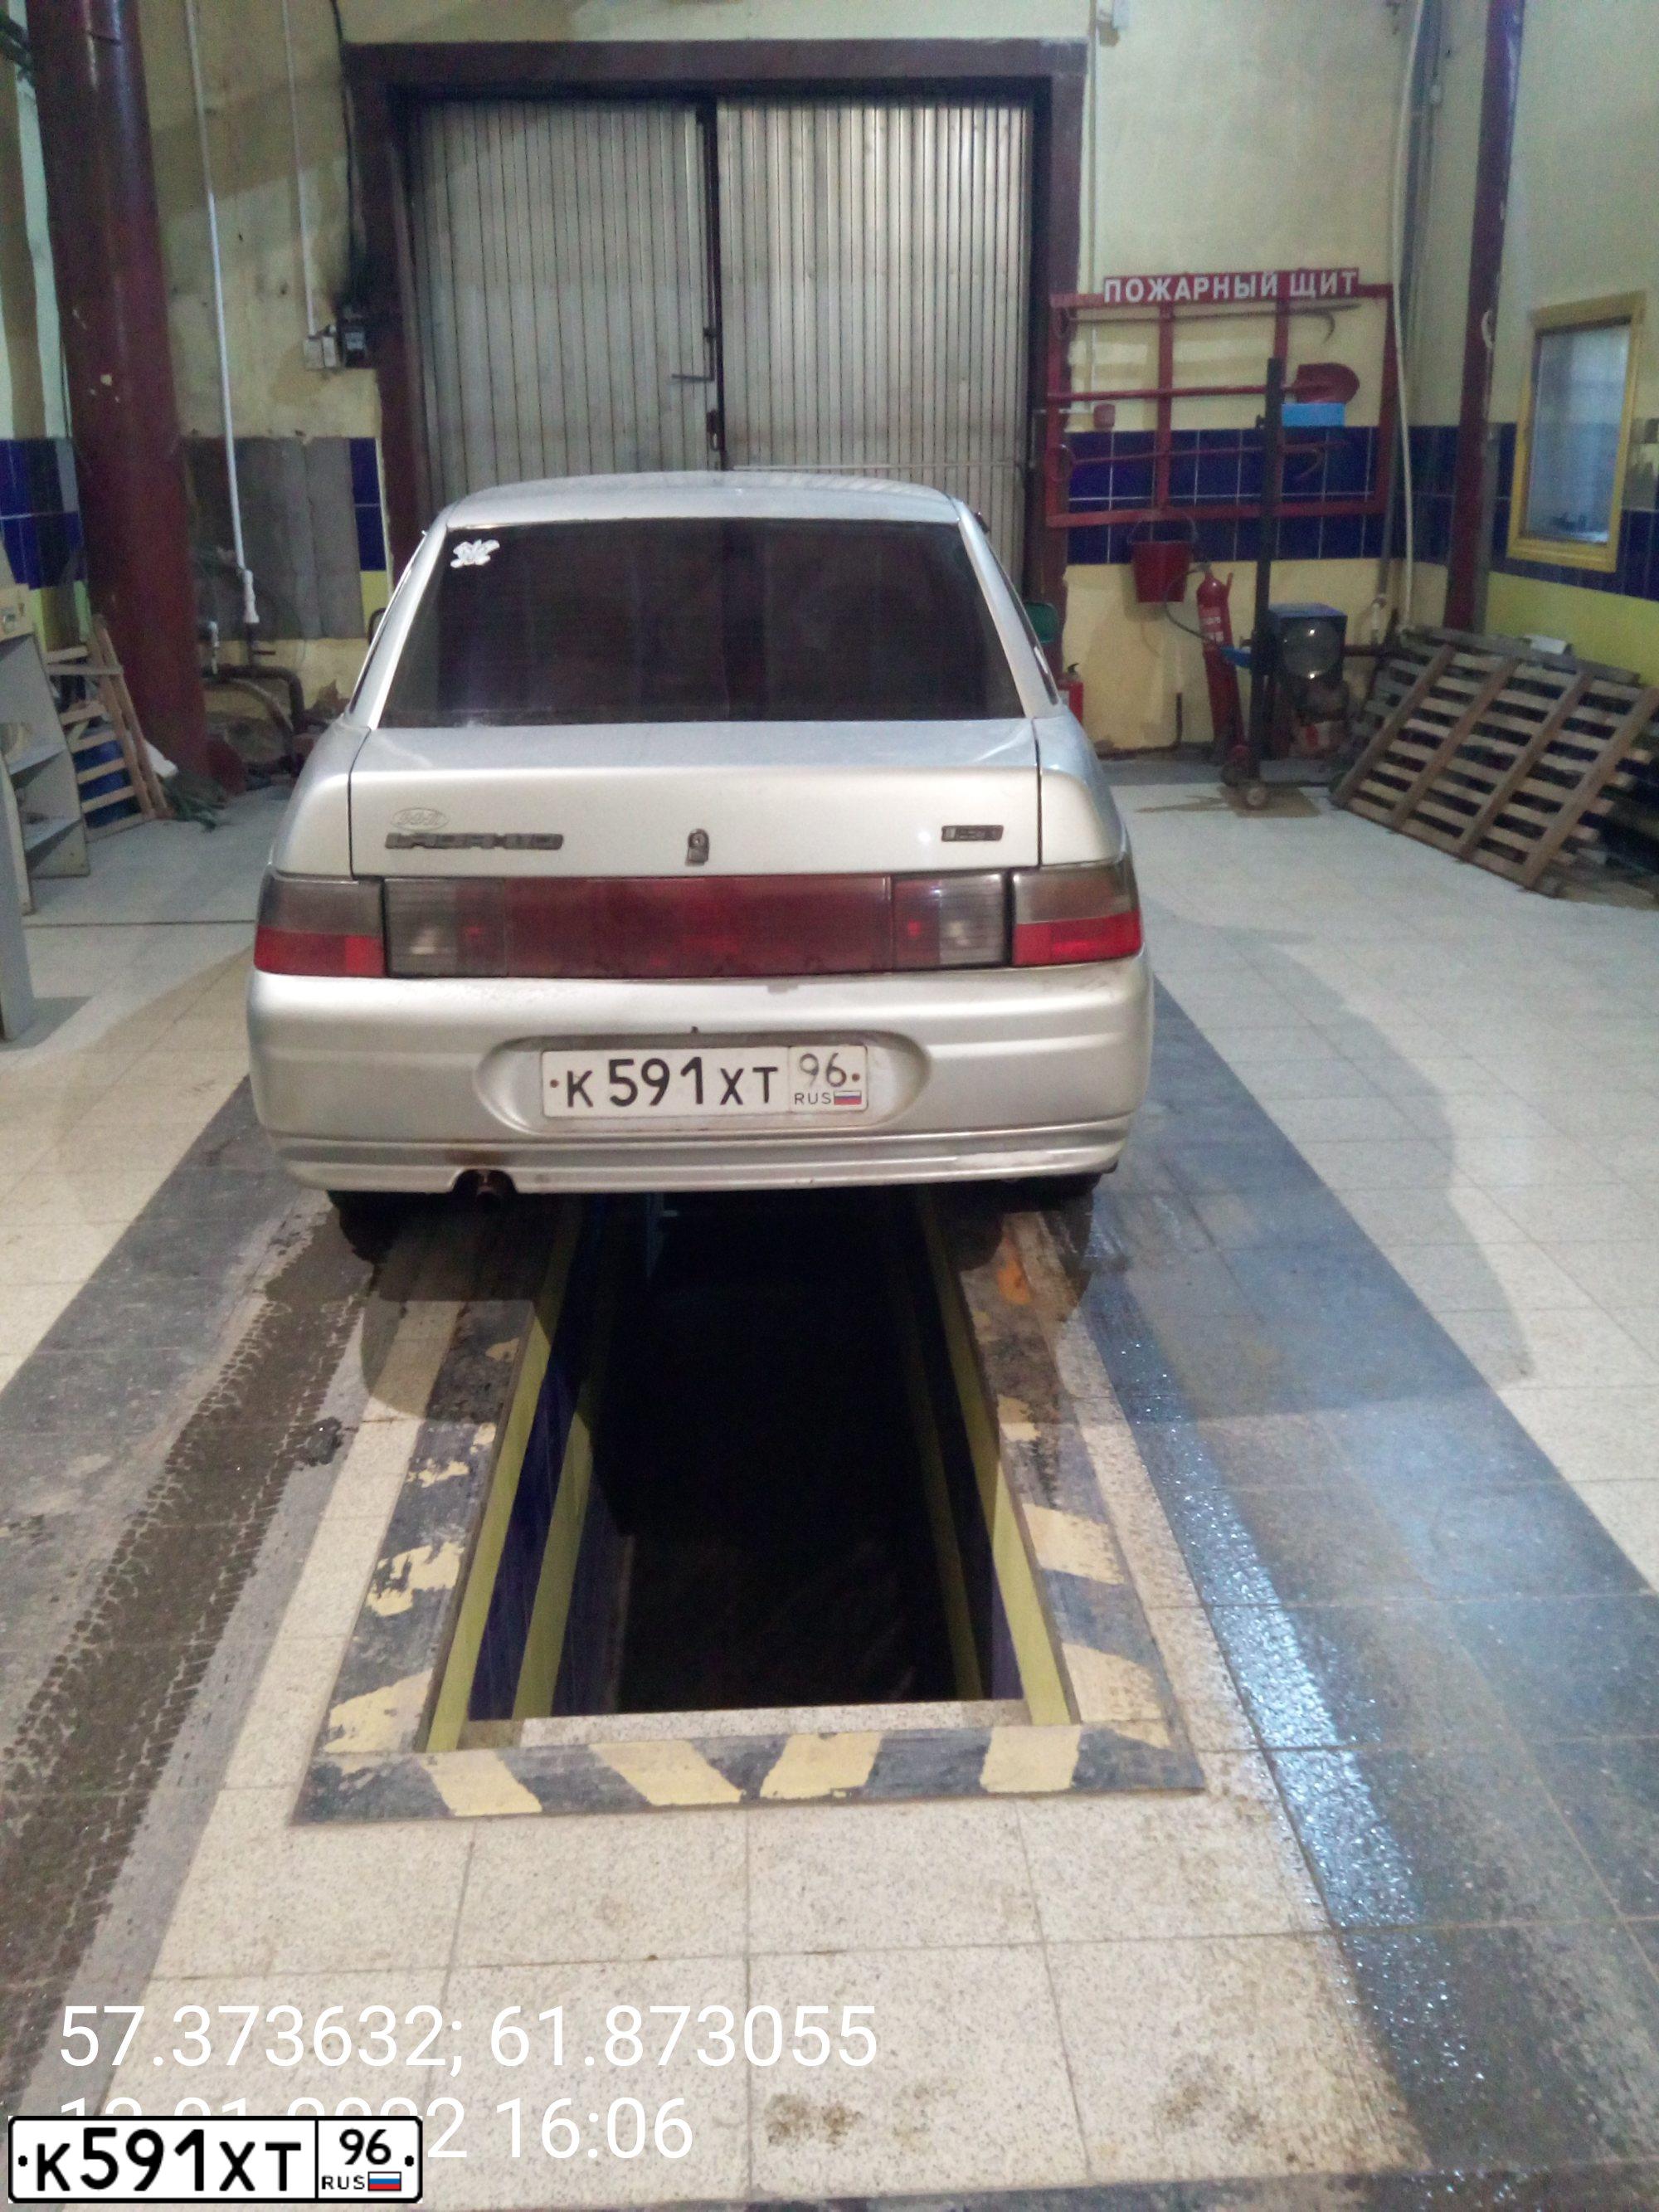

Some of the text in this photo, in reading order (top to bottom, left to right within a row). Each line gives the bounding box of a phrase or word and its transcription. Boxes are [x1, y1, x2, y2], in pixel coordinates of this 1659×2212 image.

[1103, 270, 1358, 303] ПОЖАРНЫЙ ЩИТ
[799, 1052, 847, 1088] 96
[794, 1091, 832, 1105] RUS
